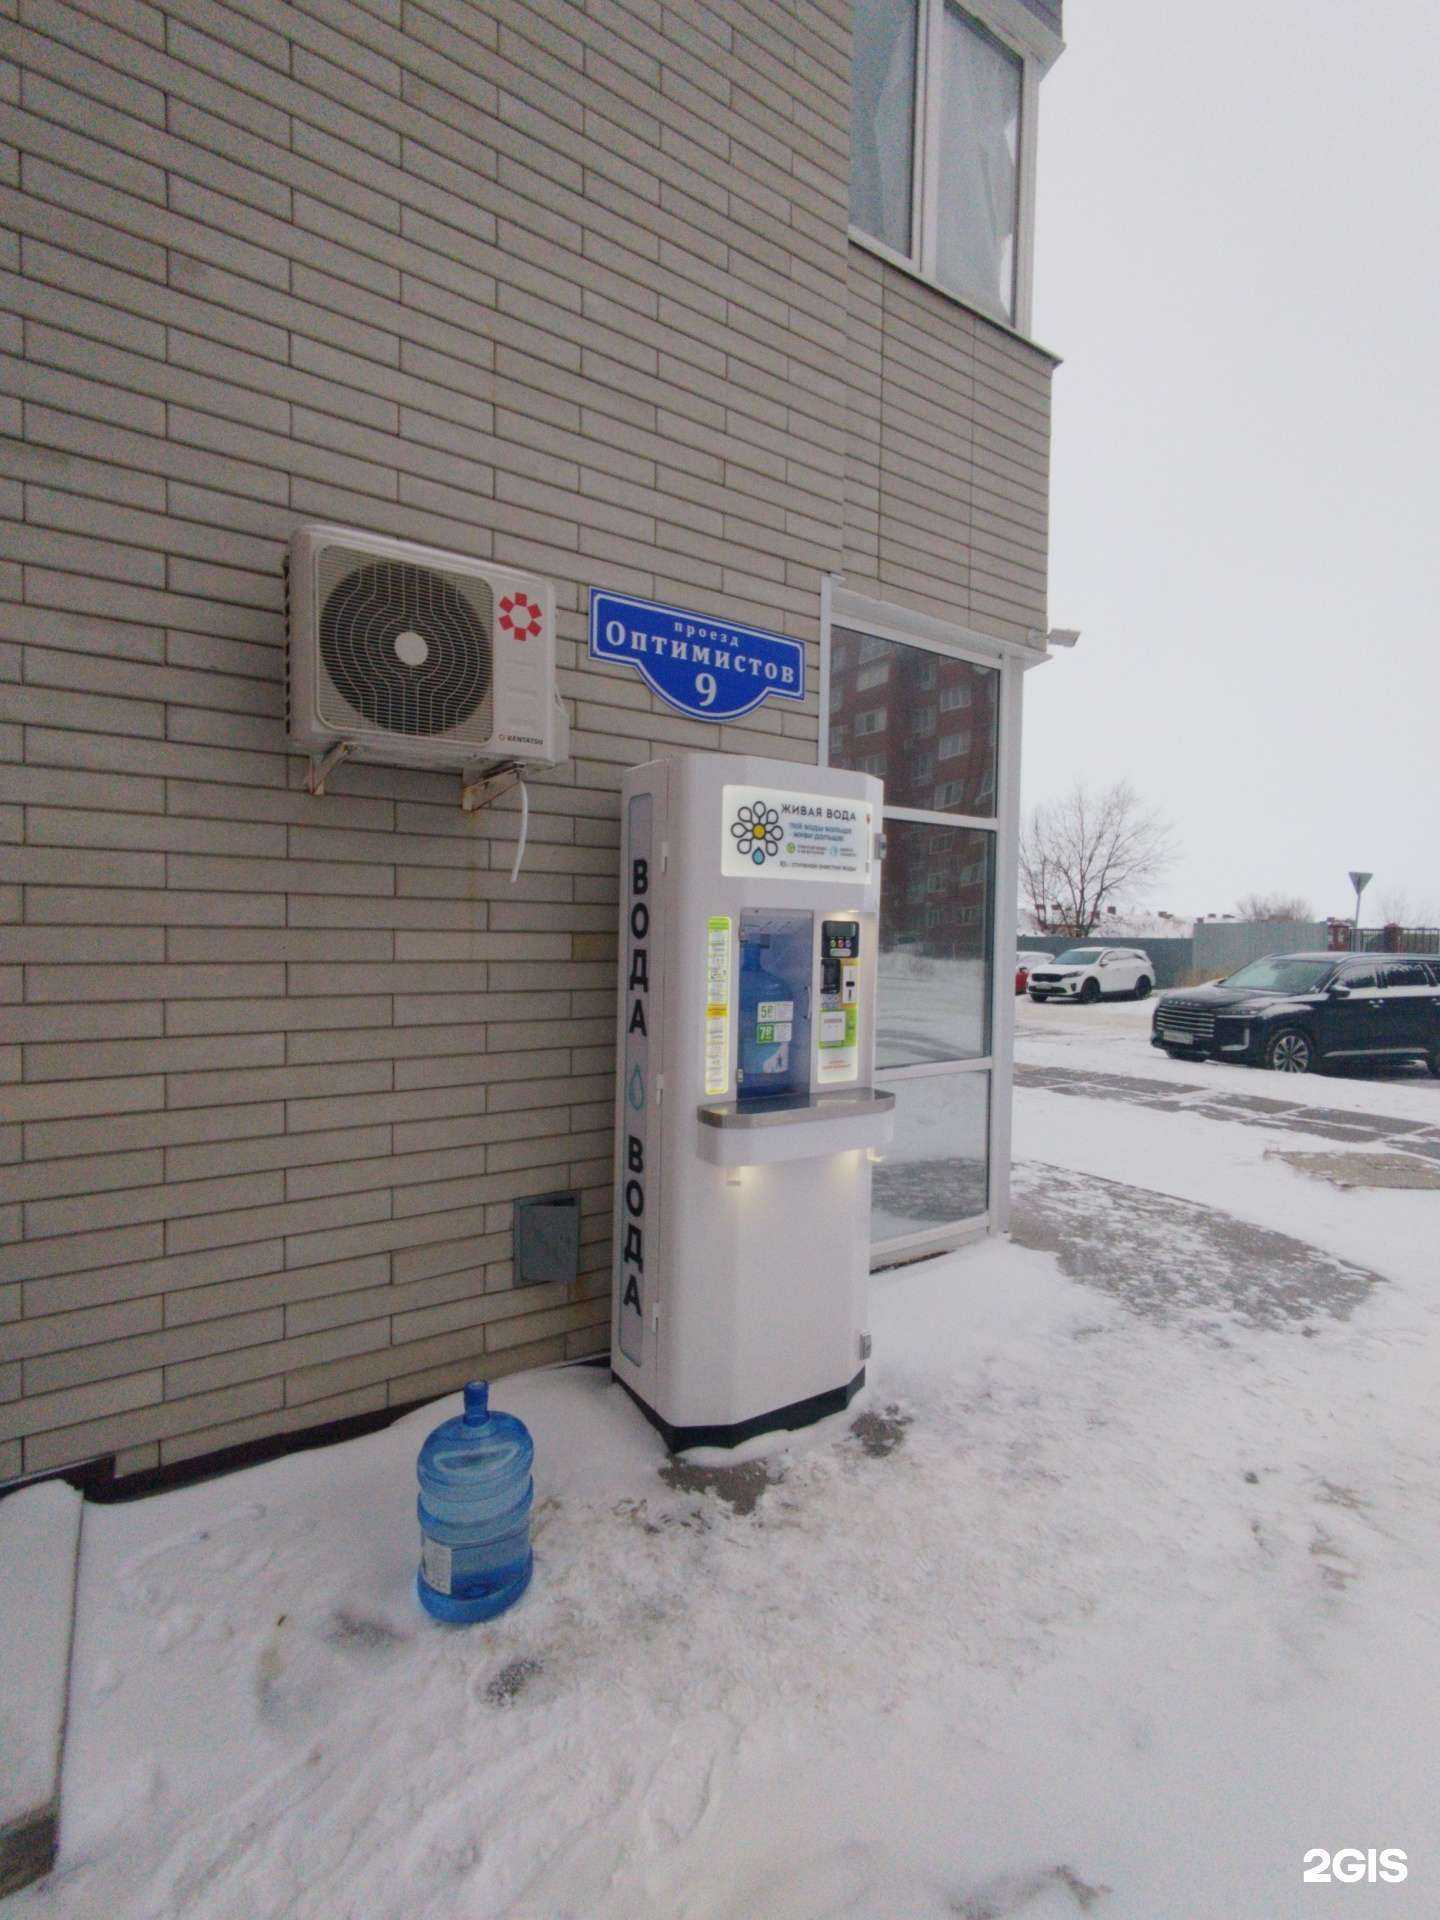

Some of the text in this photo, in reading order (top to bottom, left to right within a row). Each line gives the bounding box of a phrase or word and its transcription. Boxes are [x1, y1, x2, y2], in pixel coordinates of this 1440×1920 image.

[606, 620, 794, 684] Оптимистов
[674, 622, 739, 648] проезд
[695, 672, 718, 707] 9
[781, 804, 856, 821] ЖИВАЯ ВОДА
[629, 858, 649, 1038] ВОДА
[623, 1134, 645, 1318] ВОДА
